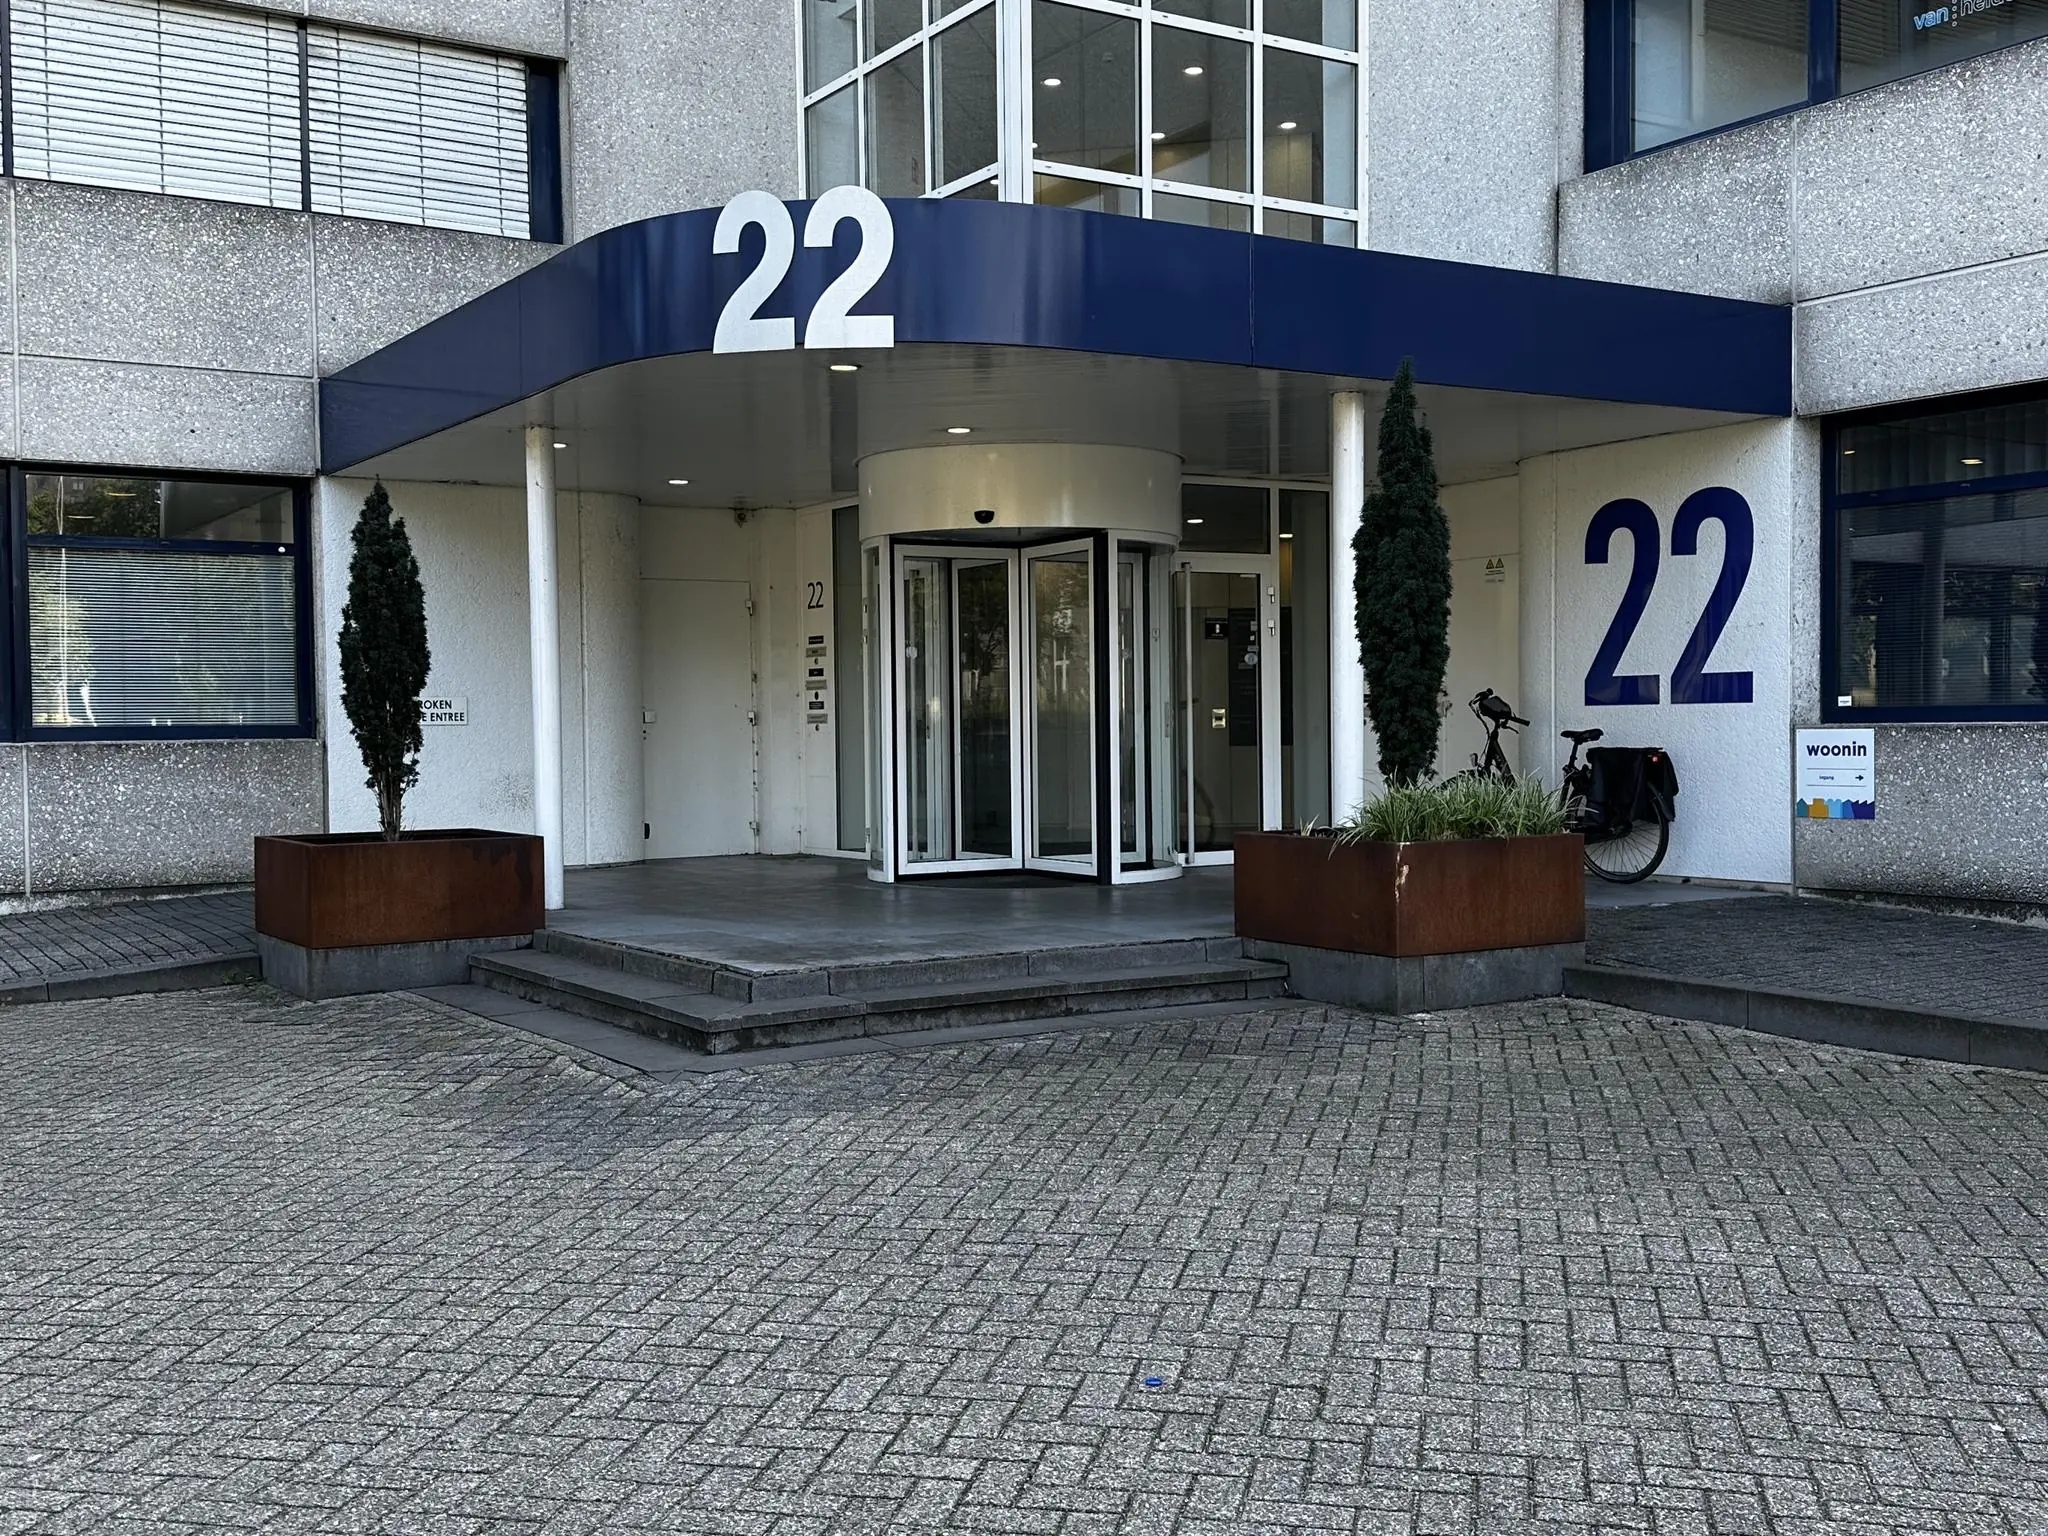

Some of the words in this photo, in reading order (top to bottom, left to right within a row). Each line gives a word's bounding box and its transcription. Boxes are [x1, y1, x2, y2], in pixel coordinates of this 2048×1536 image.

[1913, 6, 1949, 31] van
[712, 184, 895, 355] 22
[807, 581, 824, 610] 22
[1584, 486, 1754, 706] 22
[430, 712, 465, 722] ENTREE
[1806, 740, 1867, 757] woonin
